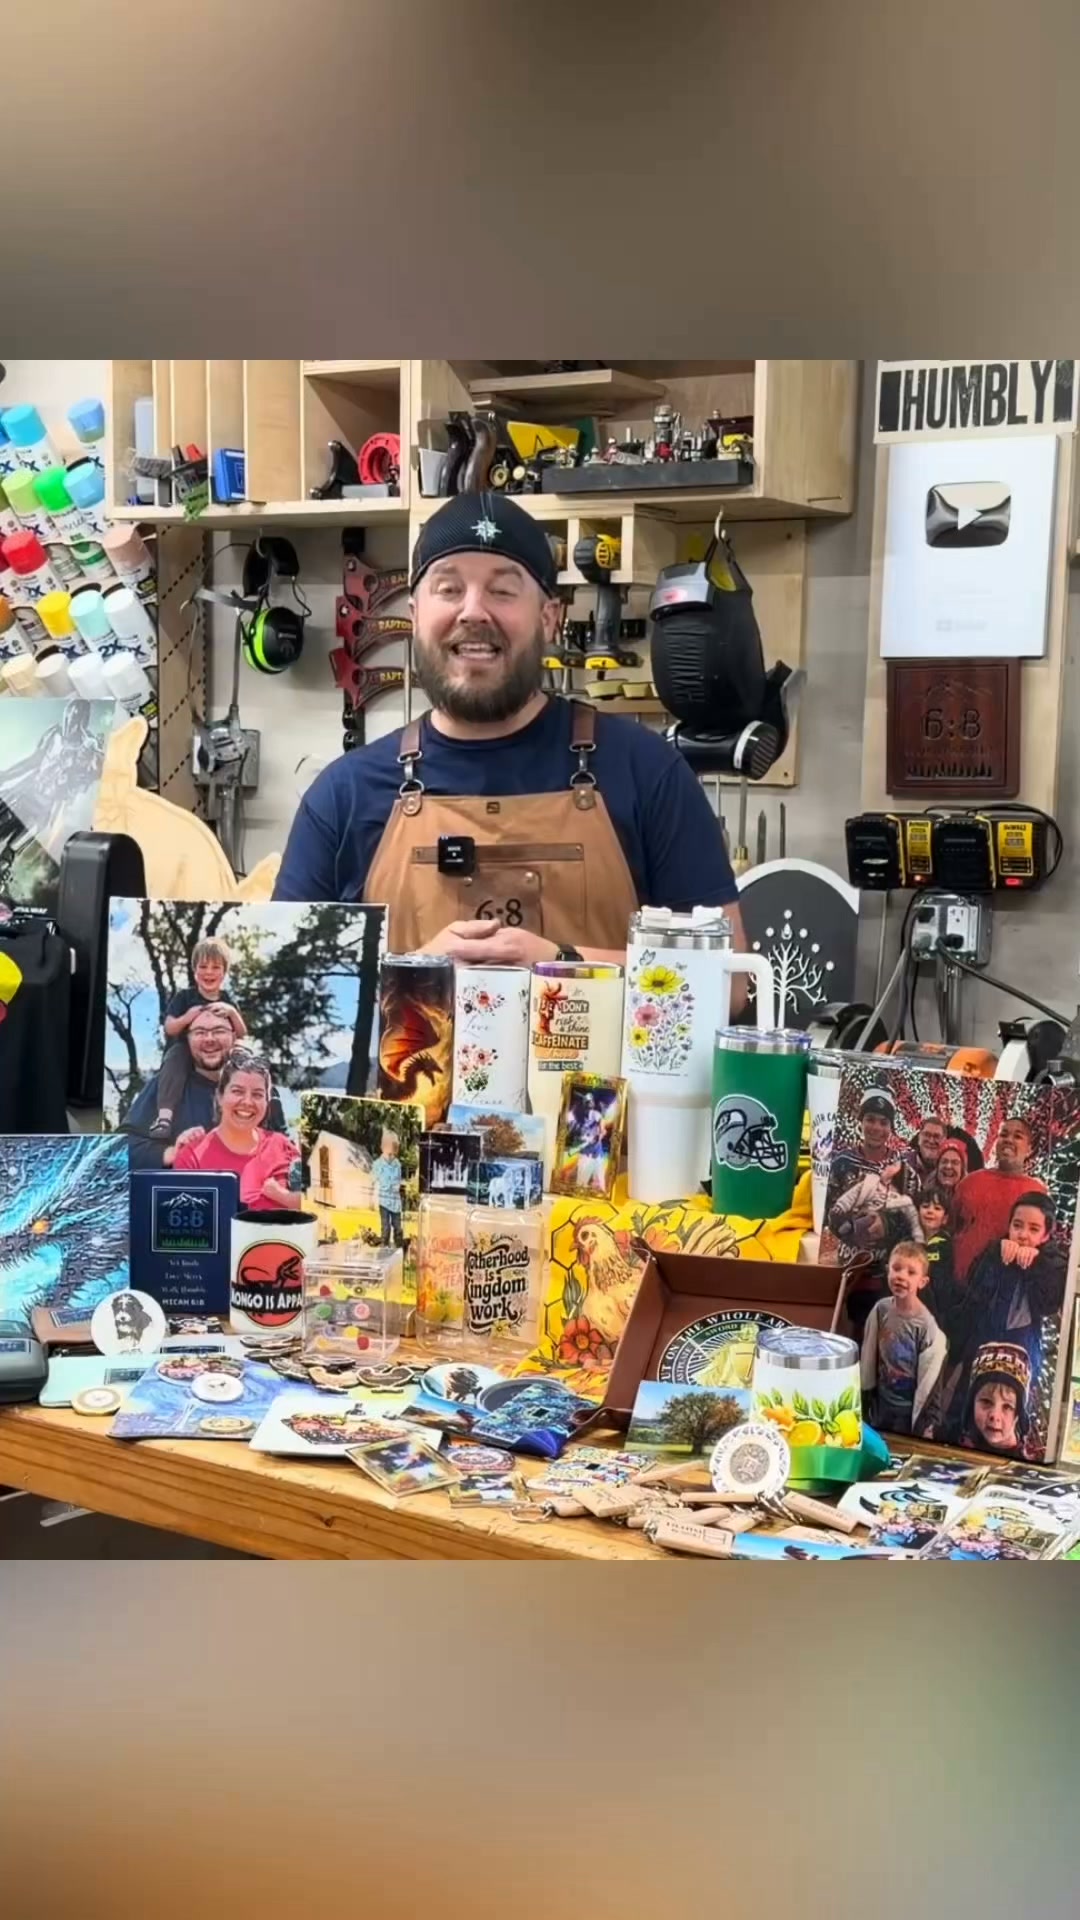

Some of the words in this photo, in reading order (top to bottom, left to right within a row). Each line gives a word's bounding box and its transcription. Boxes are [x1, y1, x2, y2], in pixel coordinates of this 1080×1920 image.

[901, 361, 1053, 431] HUMBLY
[99, 640, 126, 658] 2X
[923, 708, 981, 741] 6:8
[534, 1032, 588, 1049] CAFFEINATE
[169, 1209, 204, 1228] 6:8
[485, 1268, 495, 1281] is
[265, 1295, 275, 1310] IS
[470, 1297, 518, 1320] work
[665, 1344, 680, 1360] ON
[676, 1322, 704, 1342] THE
[706, 1311, 763, 1325] WHOLE
